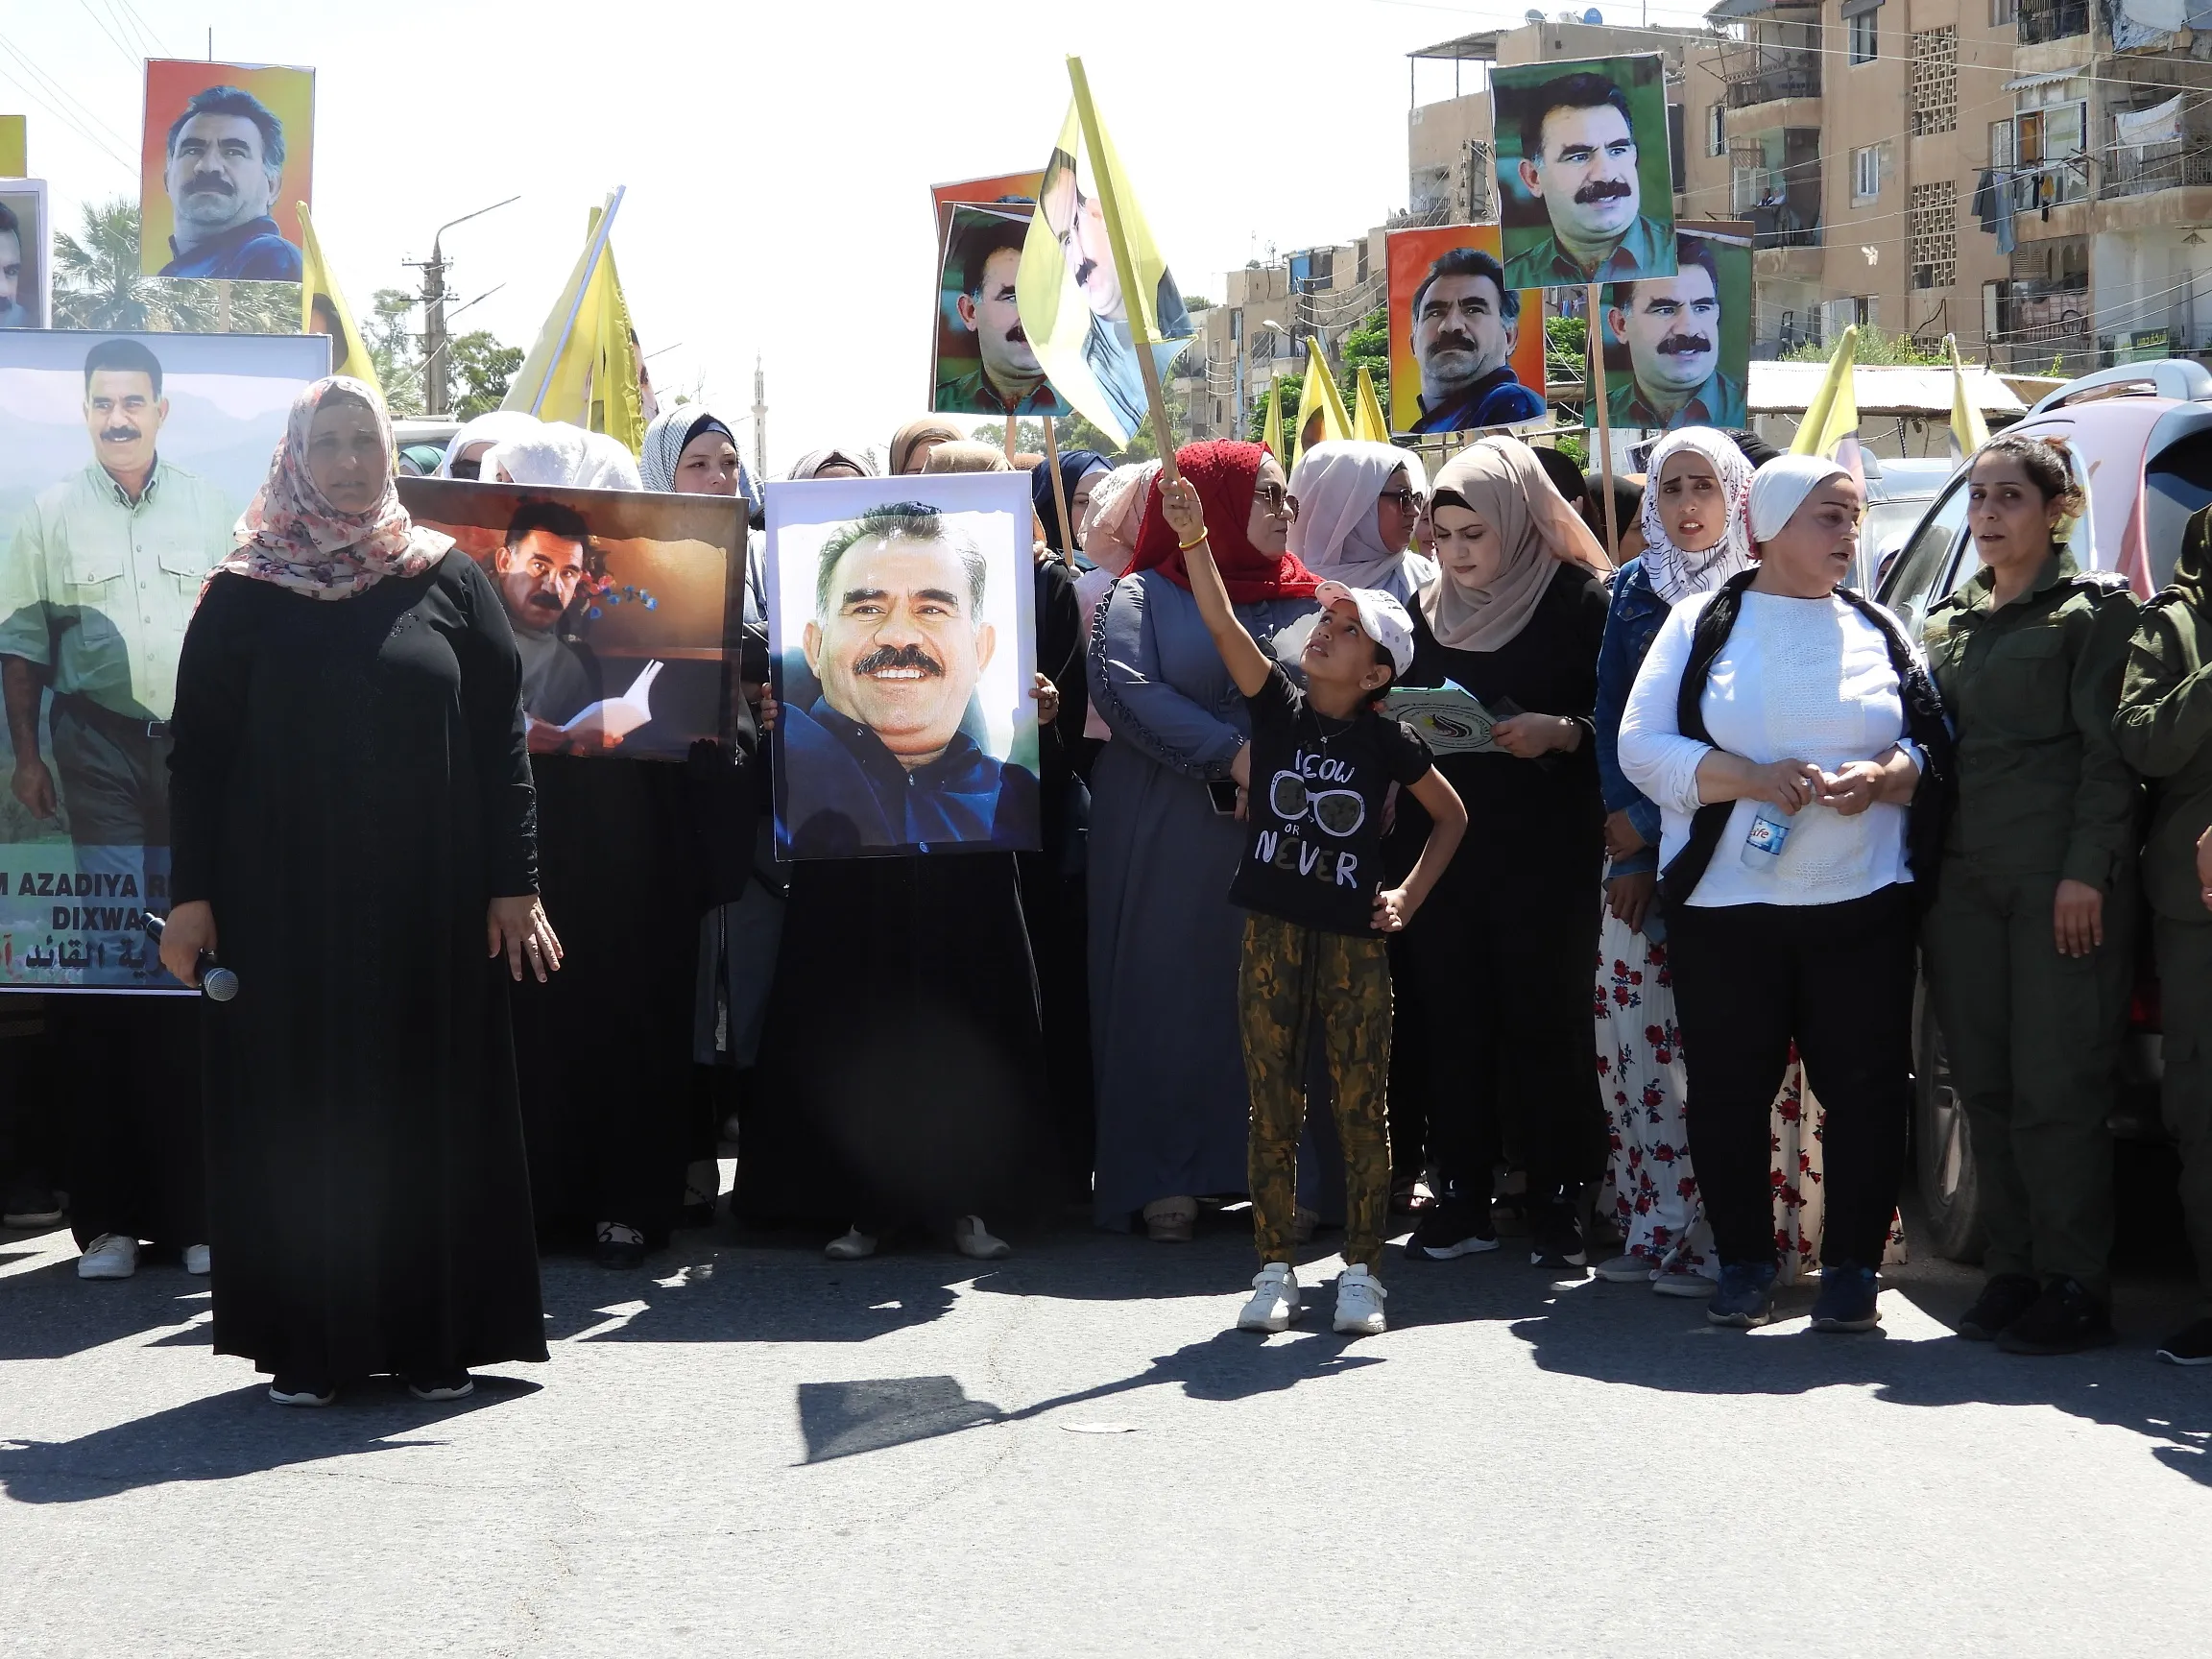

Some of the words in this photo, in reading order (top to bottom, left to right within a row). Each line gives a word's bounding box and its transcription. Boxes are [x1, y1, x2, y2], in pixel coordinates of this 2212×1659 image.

[1285, 823, 1300, 836] OR
[1254, 830, 1358, 889] NEVER
[17, 872, 139, 898] AZADIYA
